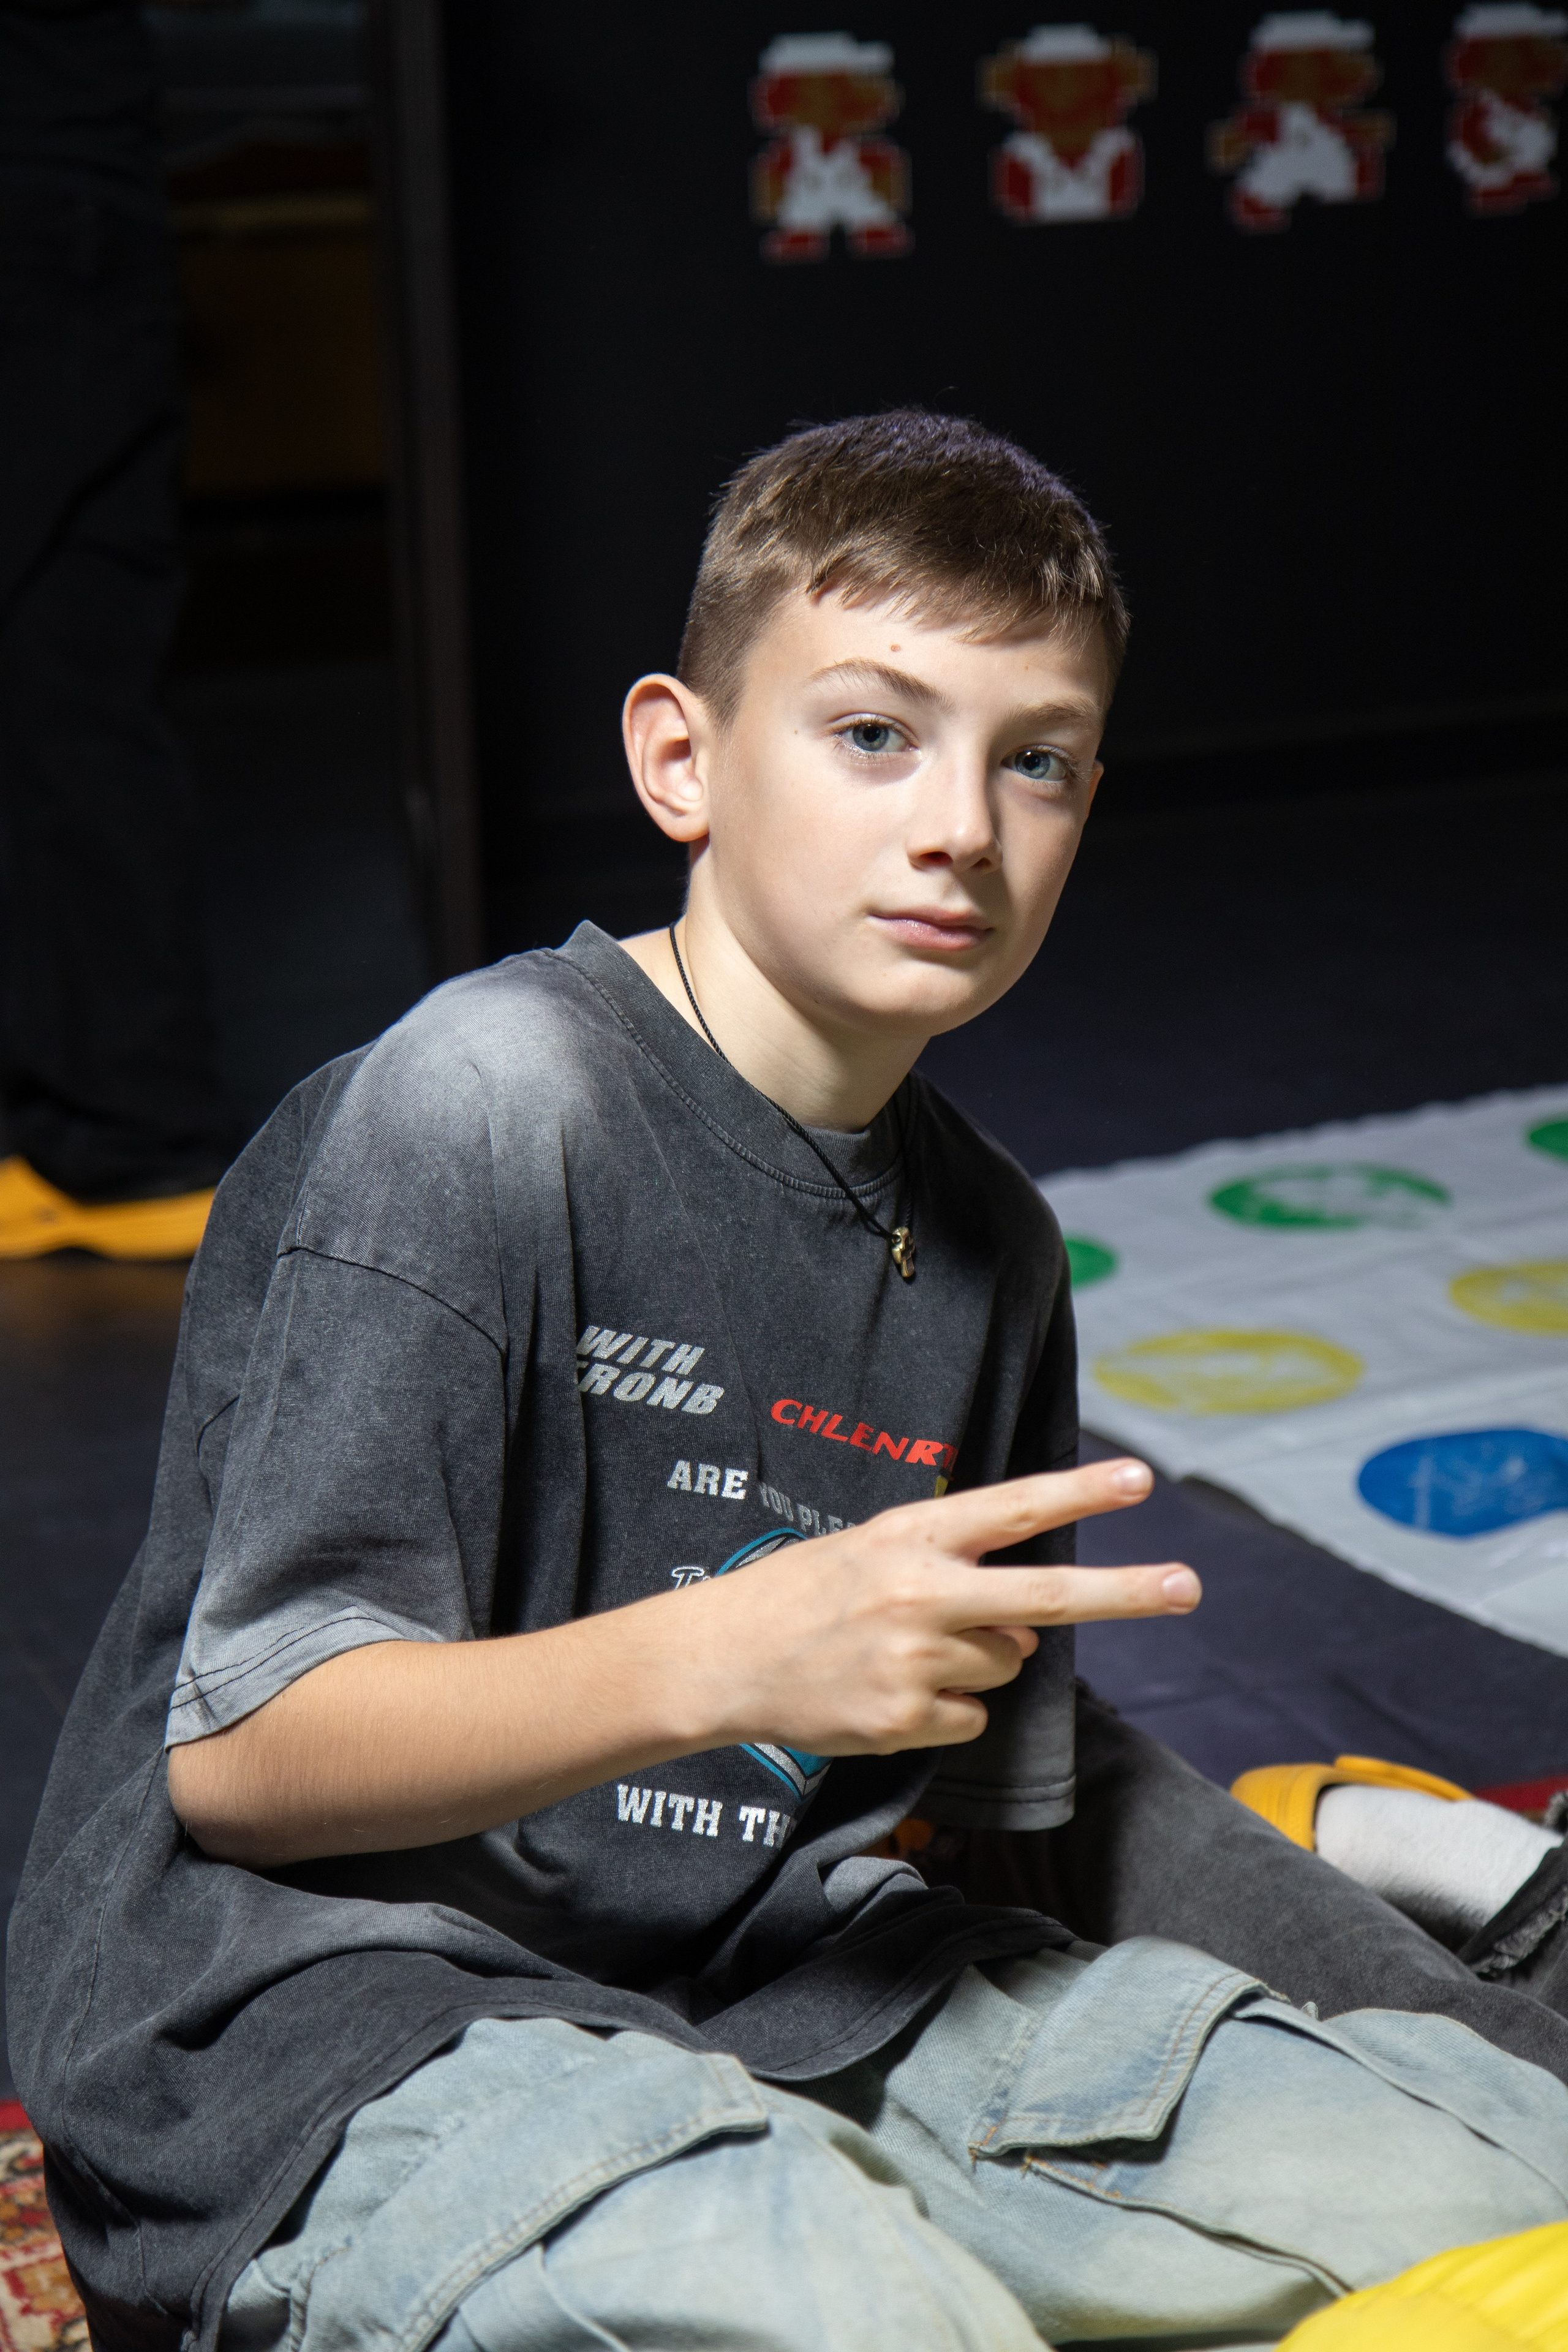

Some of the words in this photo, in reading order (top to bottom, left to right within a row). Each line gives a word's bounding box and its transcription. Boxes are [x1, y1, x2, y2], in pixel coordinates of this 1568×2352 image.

[576, 1325, 705, 1375] WITH
[576, 1361, 725, 1415] RONB
[770, 1399, 959, 1474] CHLENRT
[666, 1460, 748, 1500] ARE
[759, 1482, 794, 1522] YOU
[797, 1503, 856, 1536] PLE
[671, 1566, 712, 1590] T
[617, 1784, 723, 1837] WITH
[739, 1805, 797, 1849] TH
